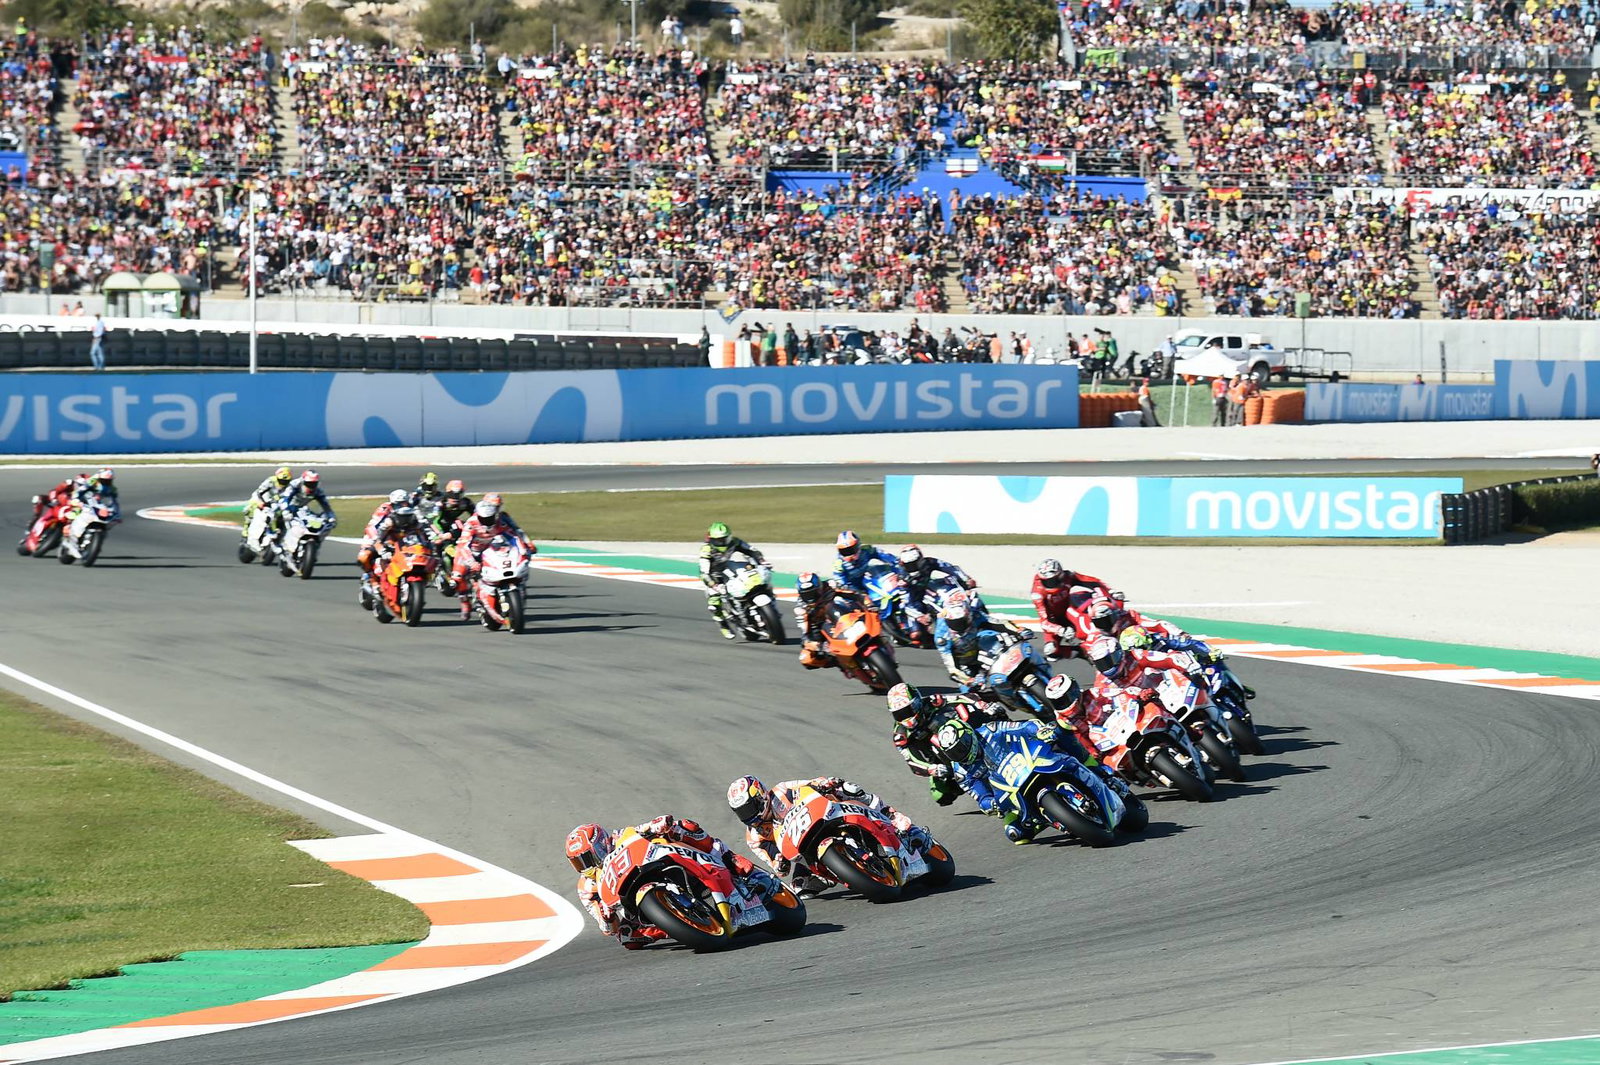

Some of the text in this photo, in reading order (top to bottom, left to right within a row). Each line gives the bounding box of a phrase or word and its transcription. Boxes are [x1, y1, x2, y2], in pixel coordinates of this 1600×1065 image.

[705, 372, 1062, 426] movistar
[1443, 388, 1493, 416] movistar
[1186, 484, 1442, 531] movistar
[1001, 752, 1028, 787] 29
[787, 805, 813, 848] 26
[604, 847, 633, 896] 93
